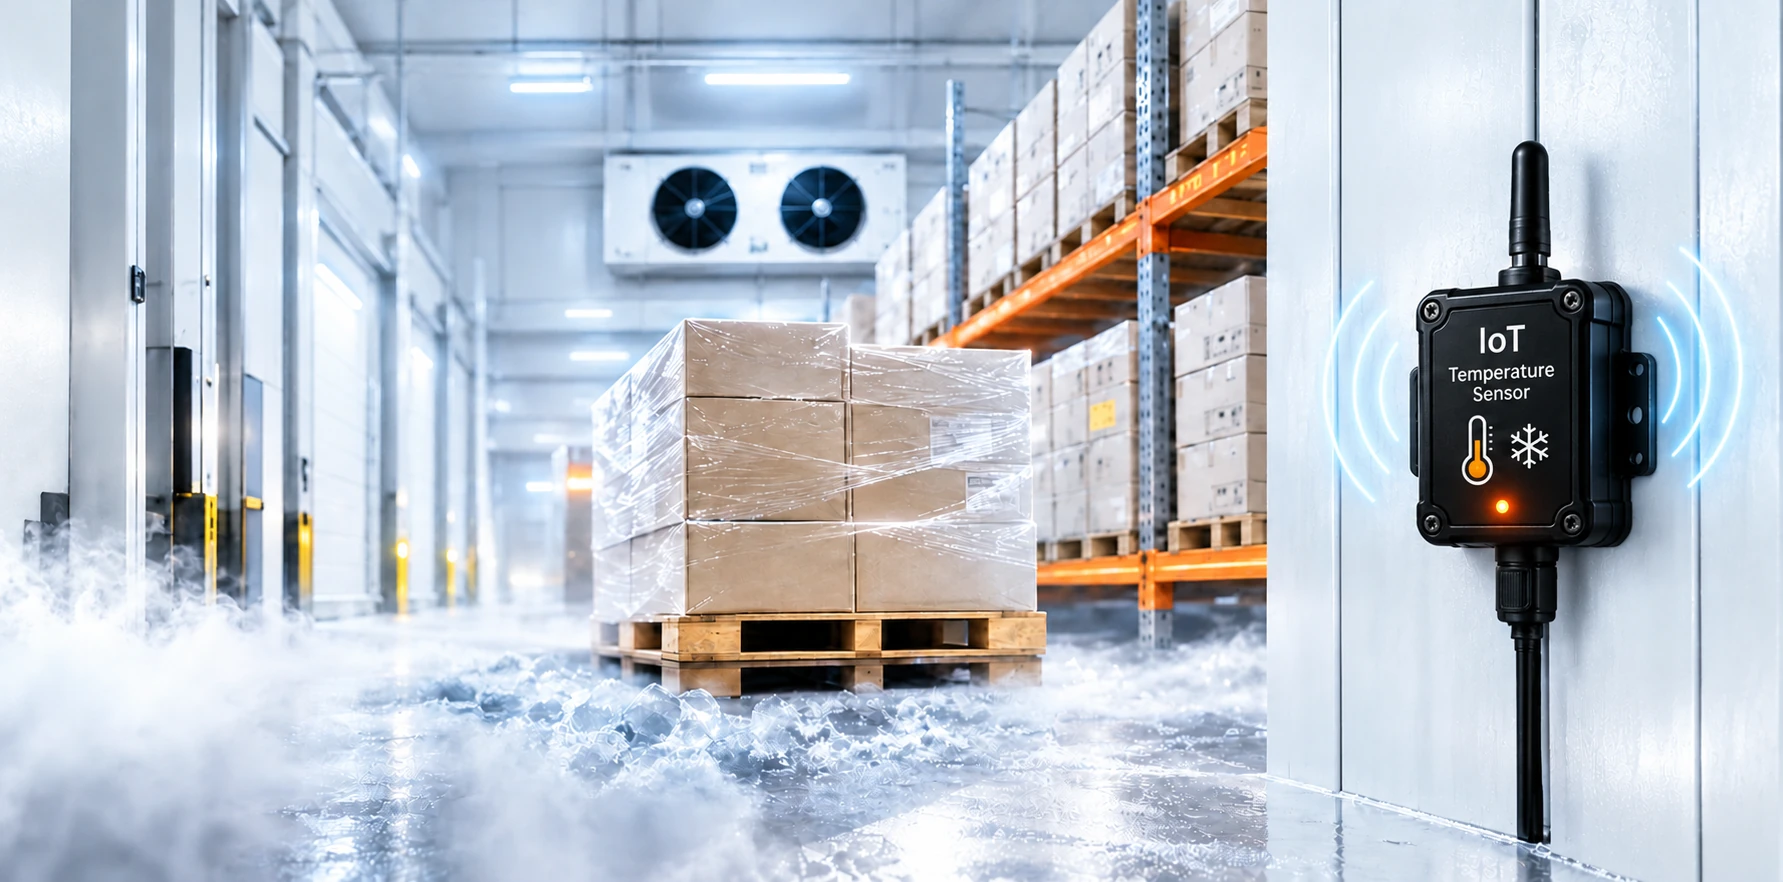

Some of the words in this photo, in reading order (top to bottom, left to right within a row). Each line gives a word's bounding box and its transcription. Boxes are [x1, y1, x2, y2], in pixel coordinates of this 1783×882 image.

[1480, 324, 1526, 354] IoT
[1448, 364, 1555, 384] Temperature
[1473, 386, 1530, 402] Sensor
